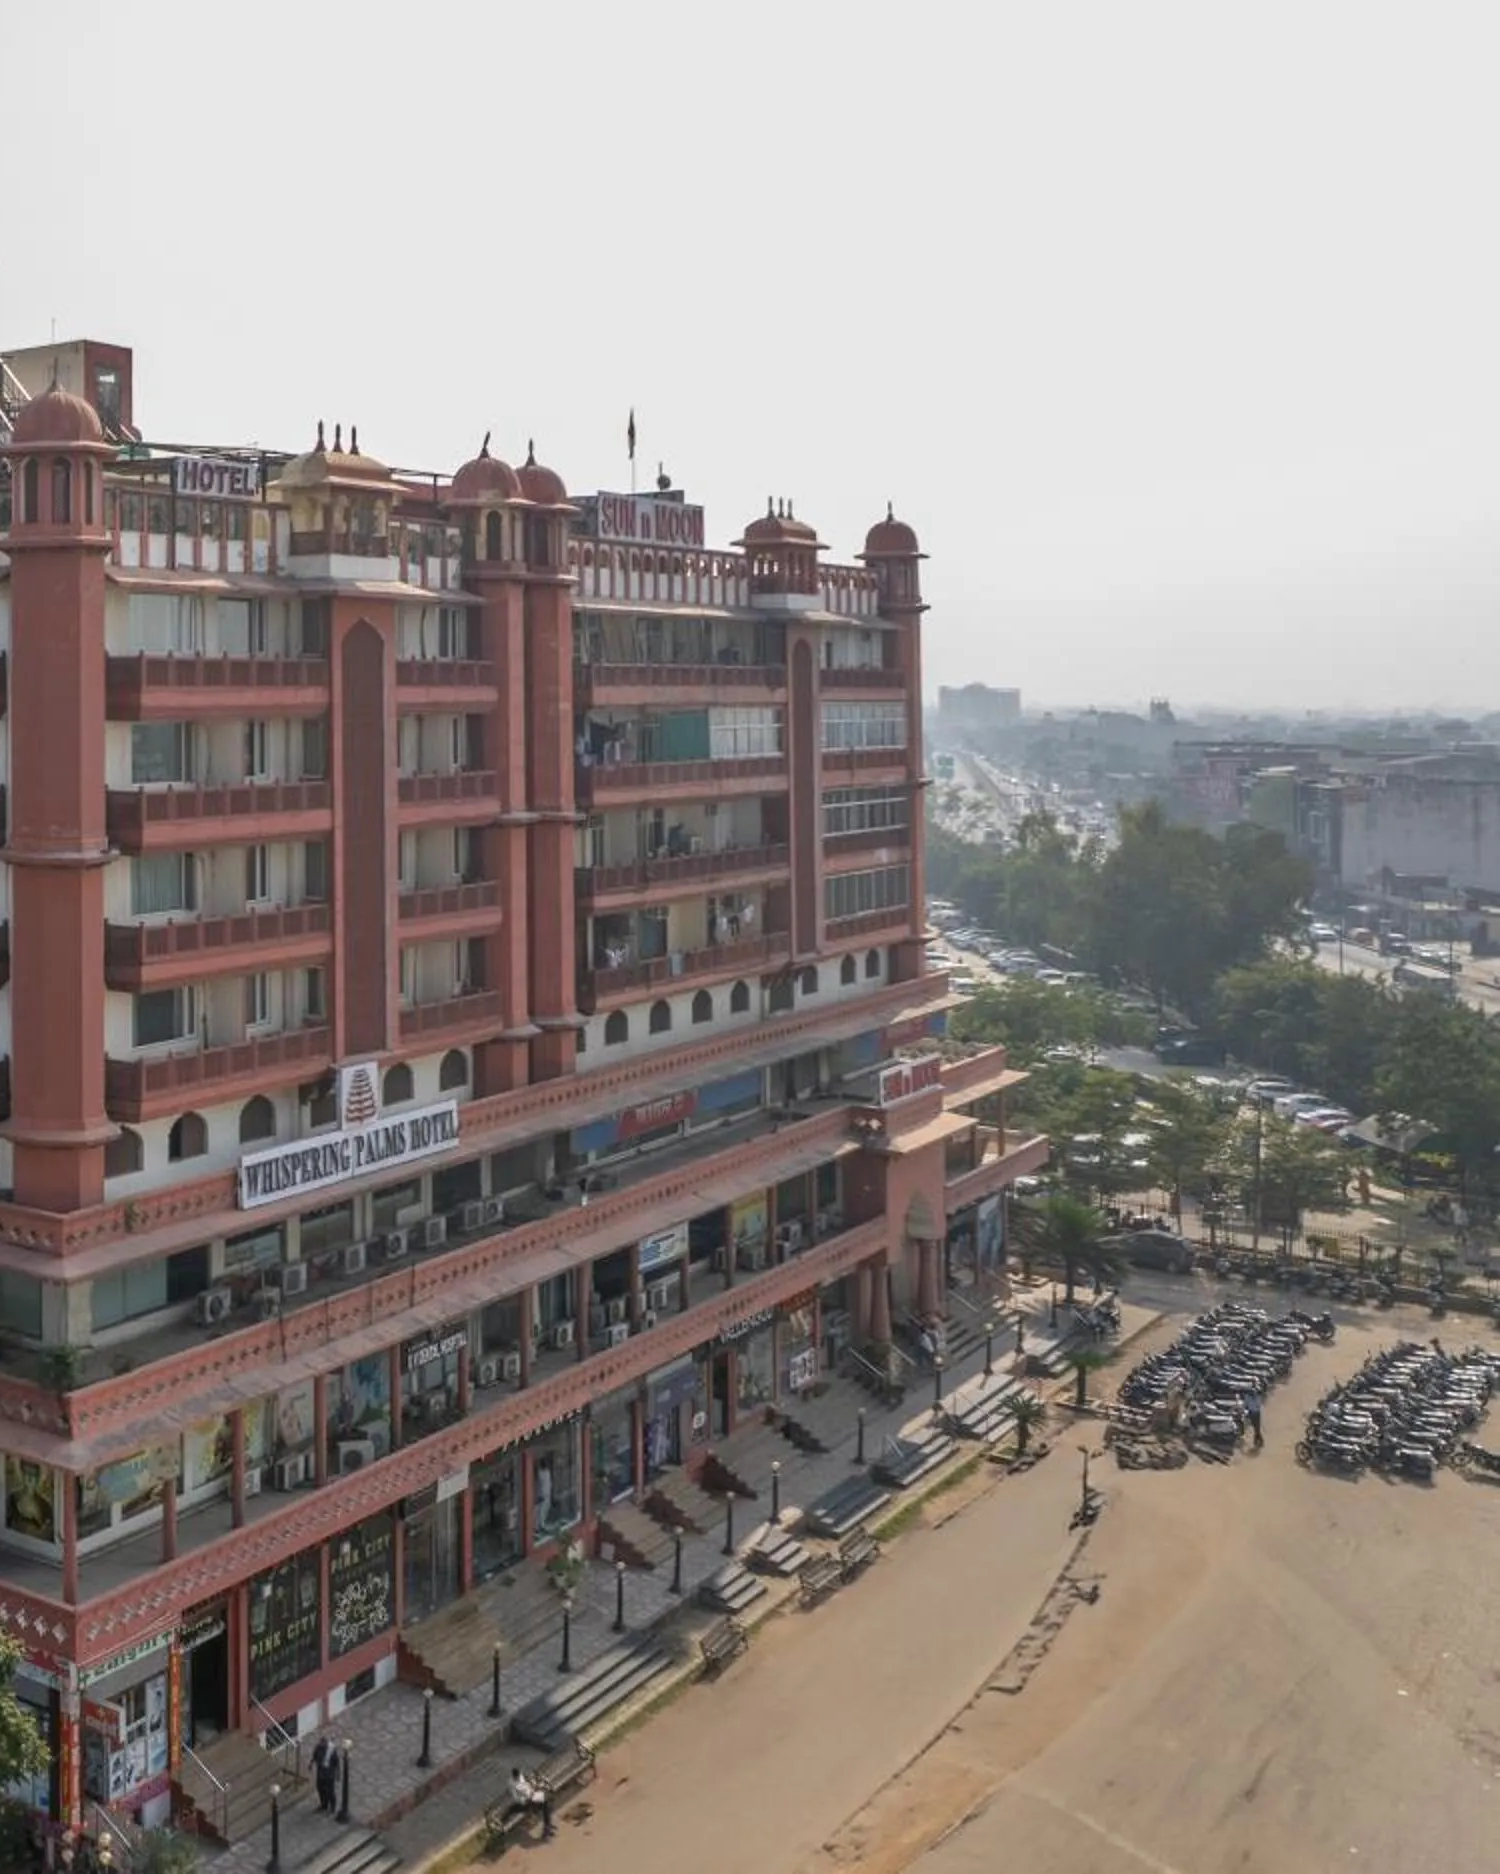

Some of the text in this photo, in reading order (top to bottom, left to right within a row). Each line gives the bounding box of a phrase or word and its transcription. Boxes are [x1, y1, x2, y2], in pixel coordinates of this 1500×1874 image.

[180, 458, 257, 497] HOTEL
[601, 496, 636, 538] SUN
[654, 504, 703, 546] MOON
[246, 1109, 458, 1197] WHISPERING PALMS HOTEL
[250, 1630, 281, 1662] PINK
[286, 1609, 317, 1640] CITY
